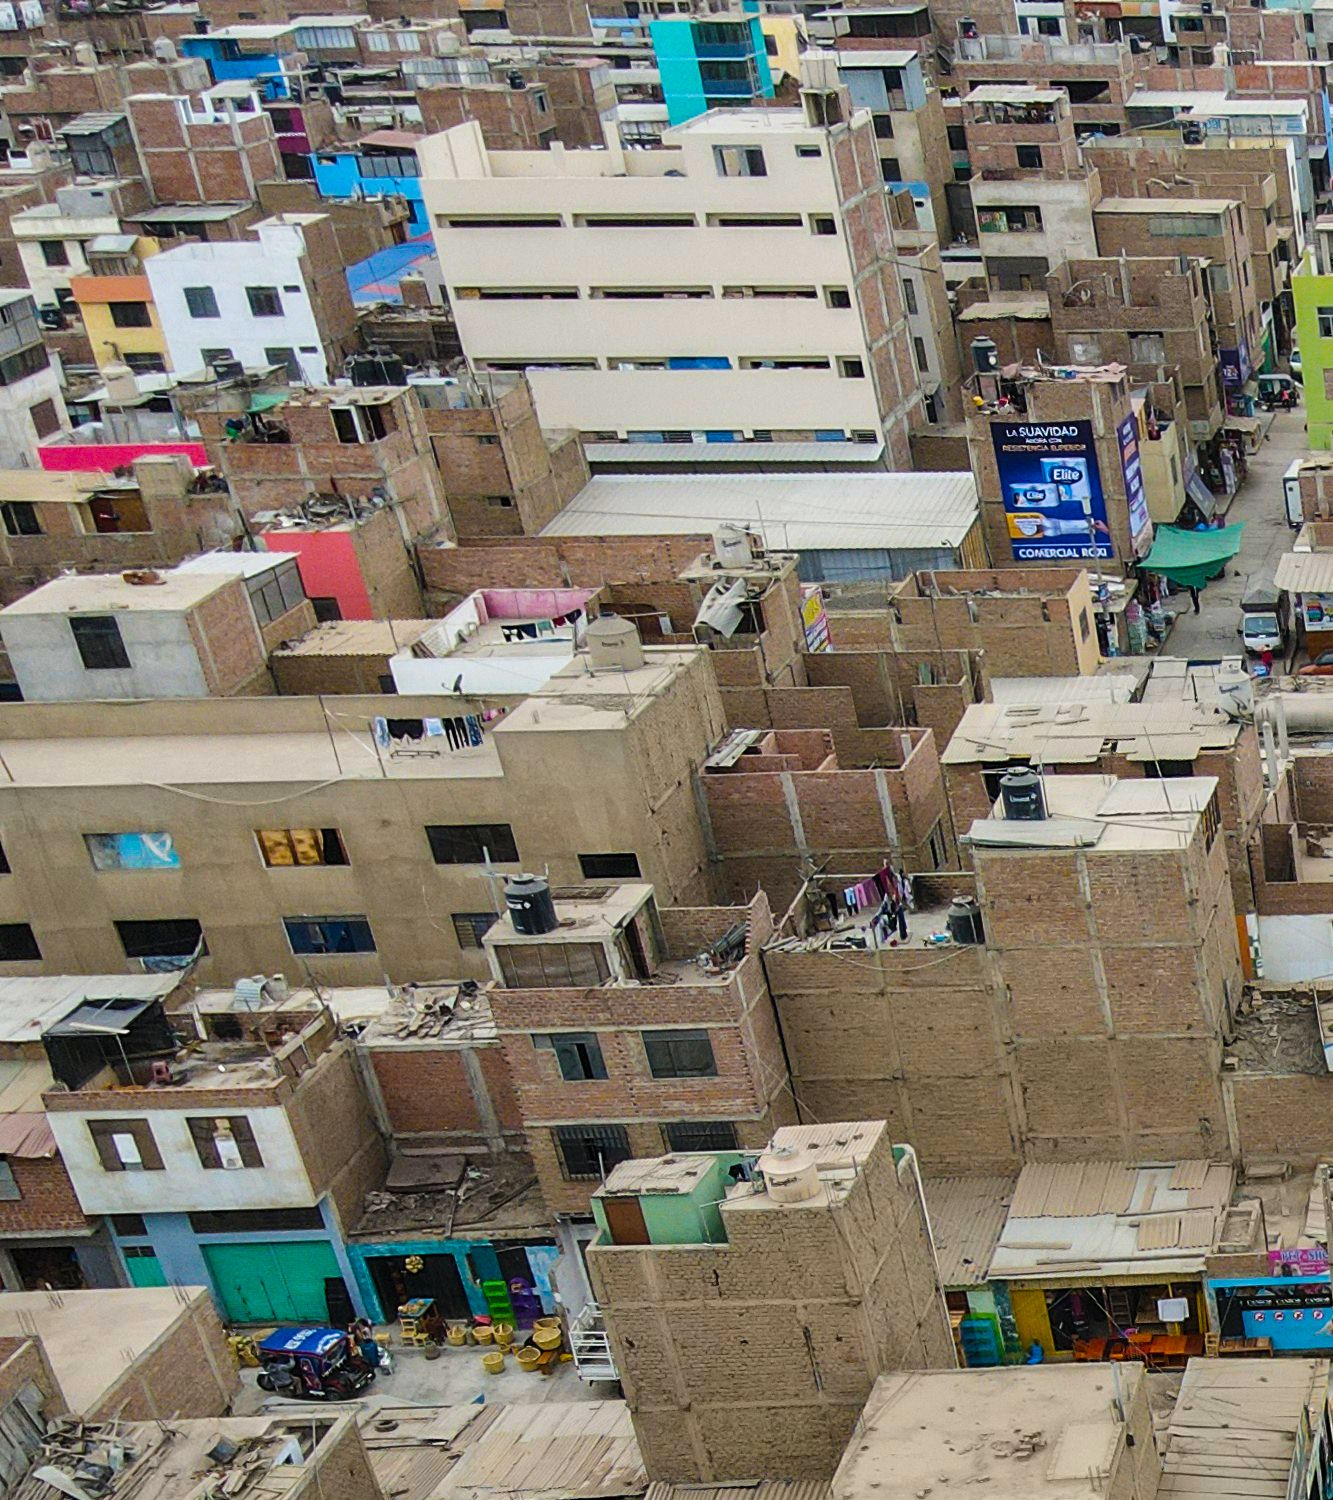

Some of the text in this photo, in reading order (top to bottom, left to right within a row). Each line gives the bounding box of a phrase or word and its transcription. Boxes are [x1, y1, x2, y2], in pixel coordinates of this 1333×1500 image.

[1019, 426, 1078, 437] SUAVIDAD
[1053, 469, 1080, 481] Elite
[1019, 548, 1079, 558] COMERCIAL
